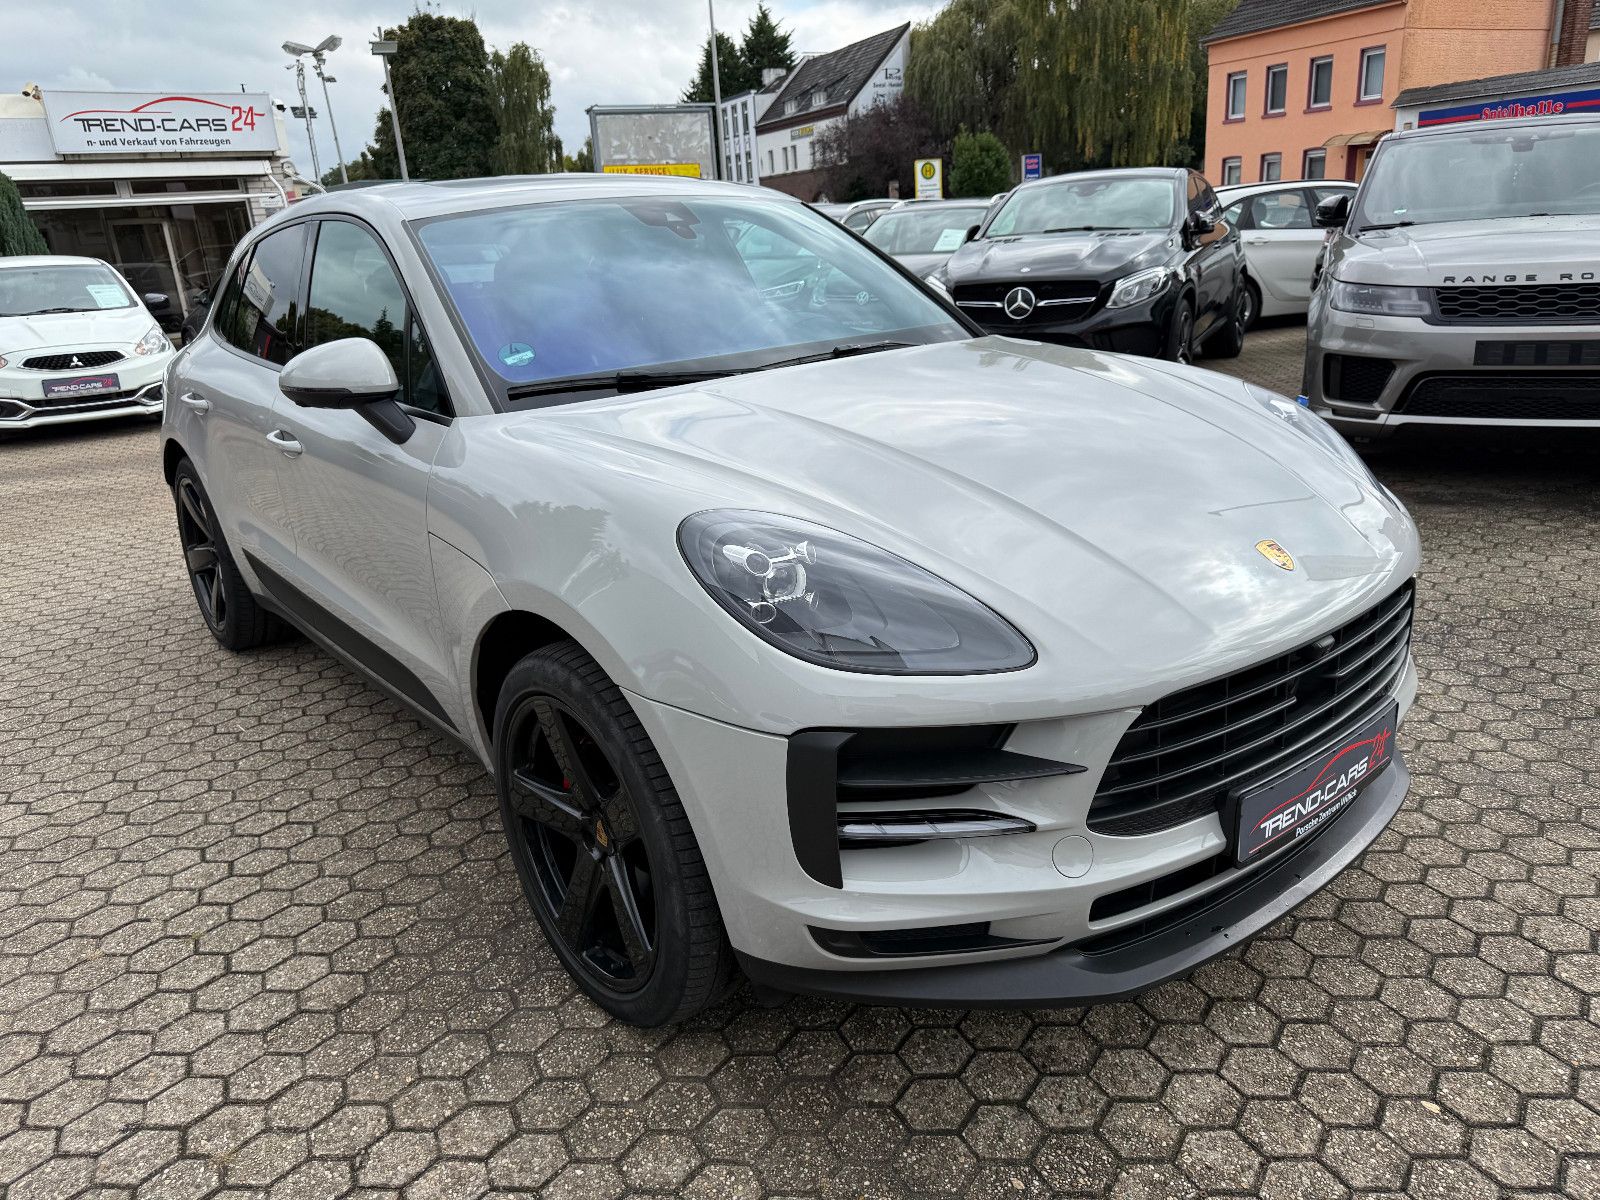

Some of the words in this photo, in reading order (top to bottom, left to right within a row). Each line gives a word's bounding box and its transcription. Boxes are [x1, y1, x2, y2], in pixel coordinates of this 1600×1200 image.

[74, 118, 228, 133] TREND-CARS
[231, 105, 256, 132] 24
[99, 137, 118, 147] und
[120, 137, 158, 147] Verkauf
[159, 138, 178, 147] von
[179, 137, 231, 147] Fahrzeugen
[1443, 274, 1538, 284] RANGE
[1559, 272, 1595, 281] RO
[1260, 756, 1369, 840] TREND-CARS
[1295, 818, 1319, 838] Porsche
[1318, 802, 1341, 823] Zentrum
